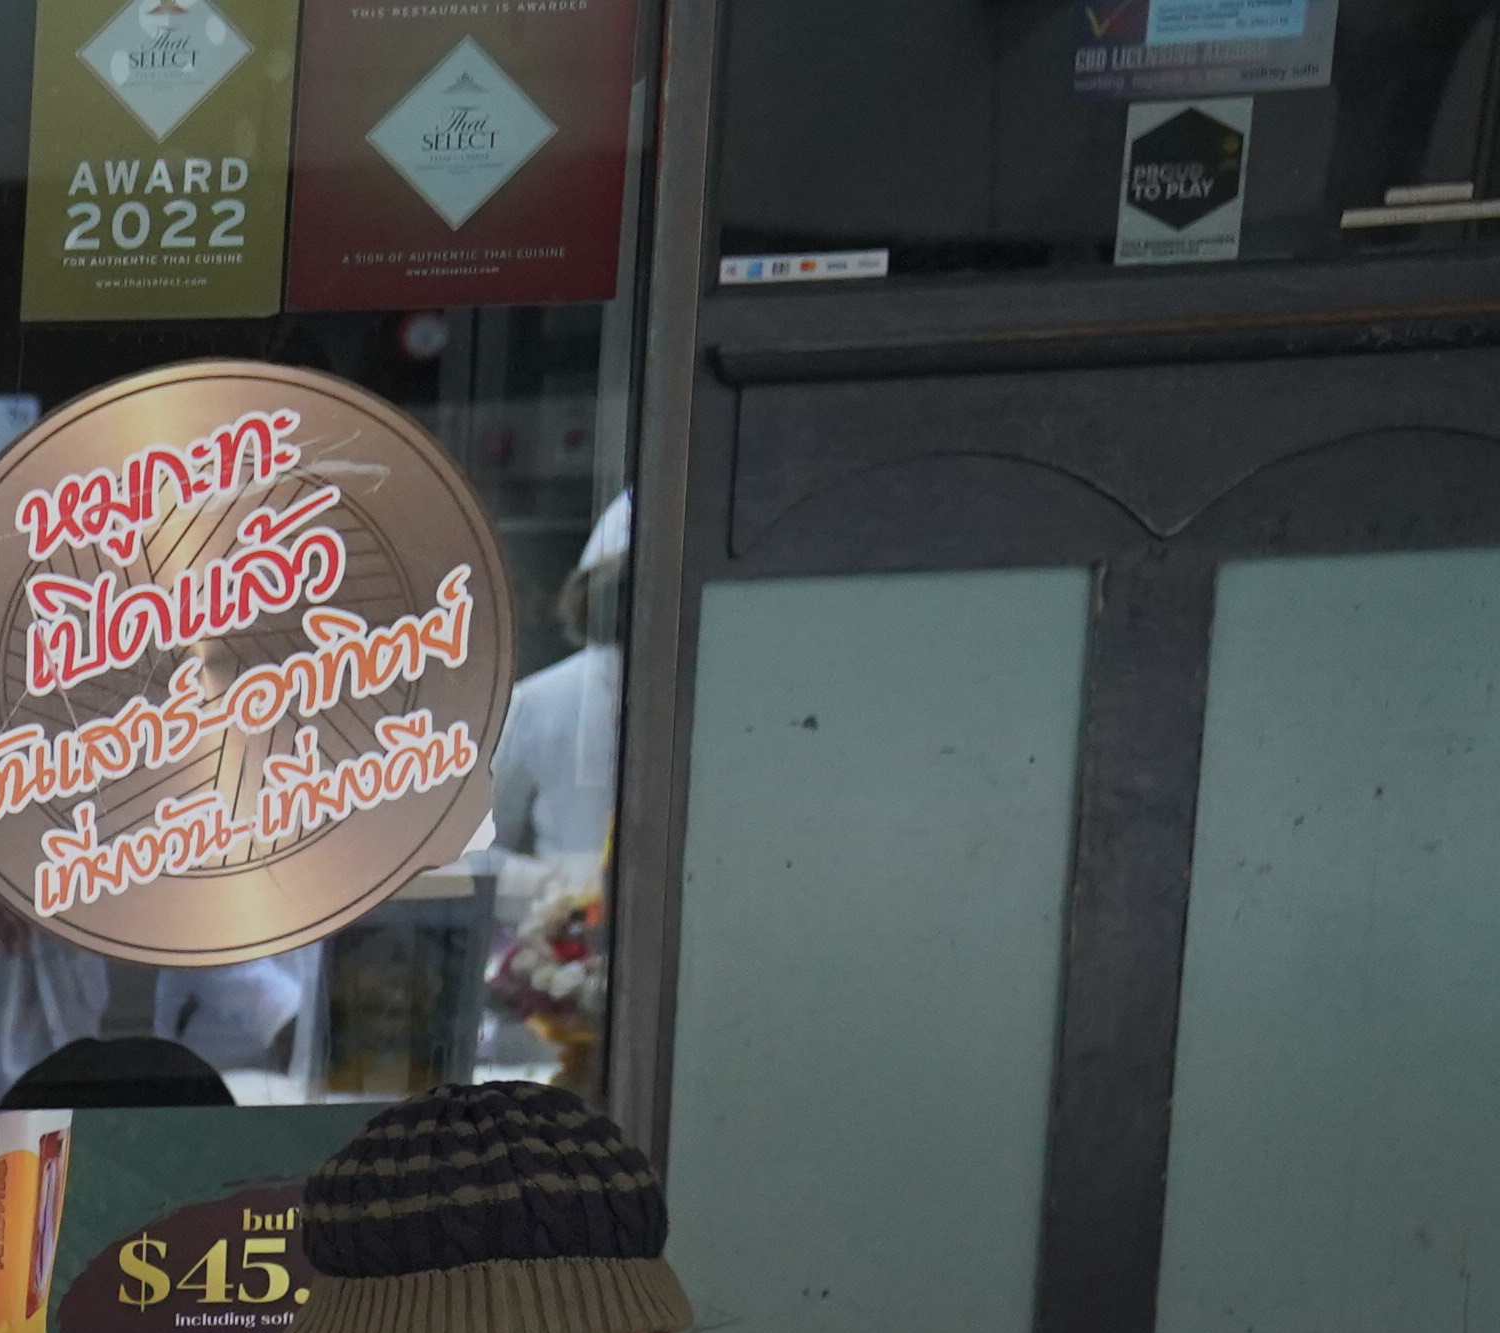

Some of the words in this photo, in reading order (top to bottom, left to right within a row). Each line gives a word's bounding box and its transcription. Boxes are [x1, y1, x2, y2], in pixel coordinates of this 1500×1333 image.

[392, 5, 487, 18] RESTAURANT
[494, 4, 510, 14] IS
[516, 0, 589, 14] AWARDED
[152, 26, 191, 50] Thai
[129, 51, 200, 69] SELECT
[446, 106, 490, 132] Thai
[422, 131, 498, 151] SELECT
[68, 157, 249, 196] AWARD
[1133, 163, 1204, 184] PROUD
[1131, 183, 1162, 200] TO
[1165, 177, 1215, 200] PLAY
[64, 198, 247, 251] 2022
[62, 257, 86, 267] FOR
[90, 254, 157, 266] AUTHENTIC
[162, 254, 190, 265] THAI
[195, 252, 243, 265] CUISINE
[342, 254, 351, 265] A
[354, 253, 384, 265] SIGN
[388, 251, 404, 263] OF
[408, 250, 478, 262] AUTHENTIC
[483, 248, 512, 259] THAI
[516, 247, 567, 259] CUISINE
[17, 411, 298, 563] หมูกะทะ
[28, 486, 344, 696] เปิดแล้ว
[242, 1206, 299, 1231] buf
[175, 1311, 256, 1328] including
